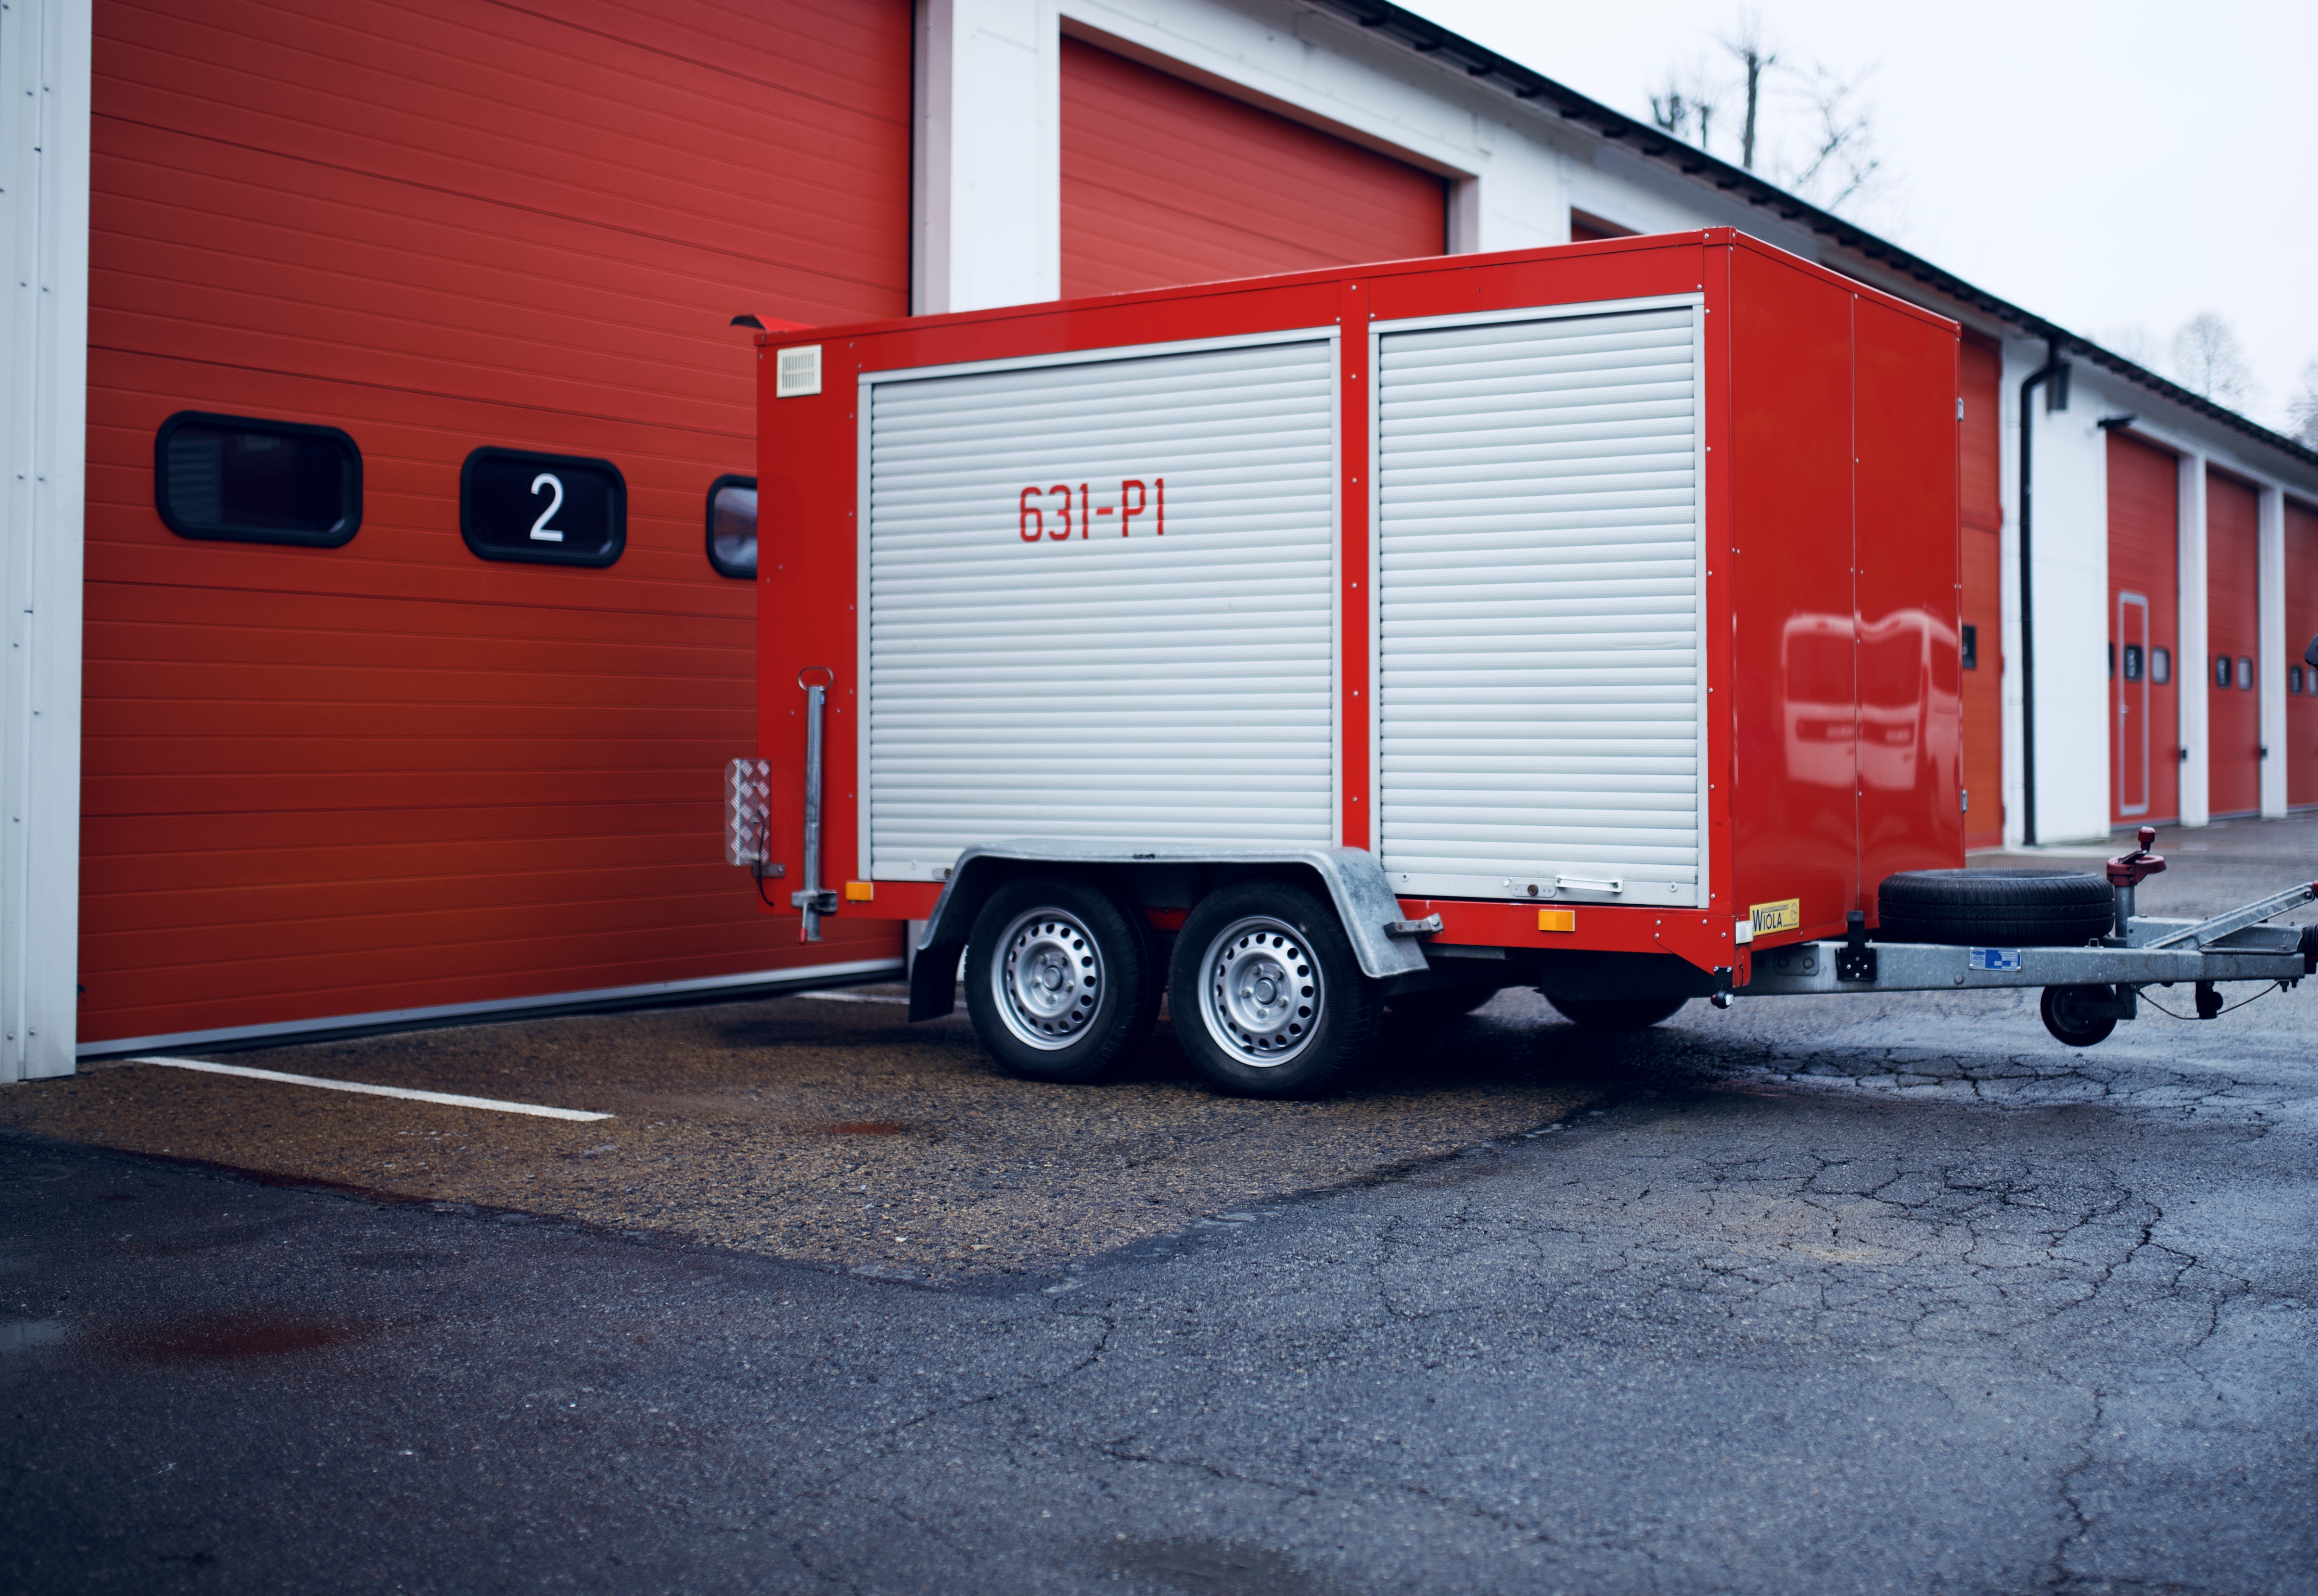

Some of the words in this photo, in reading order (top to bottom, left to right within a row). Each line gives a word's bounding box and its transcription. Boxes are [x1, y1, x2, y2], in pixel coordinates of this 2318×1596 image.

[530, 473, 564, 542] 2
[1020, 478, 1164, 543] 631-P1
[1752, 909, 1782, 932] WIOLA
